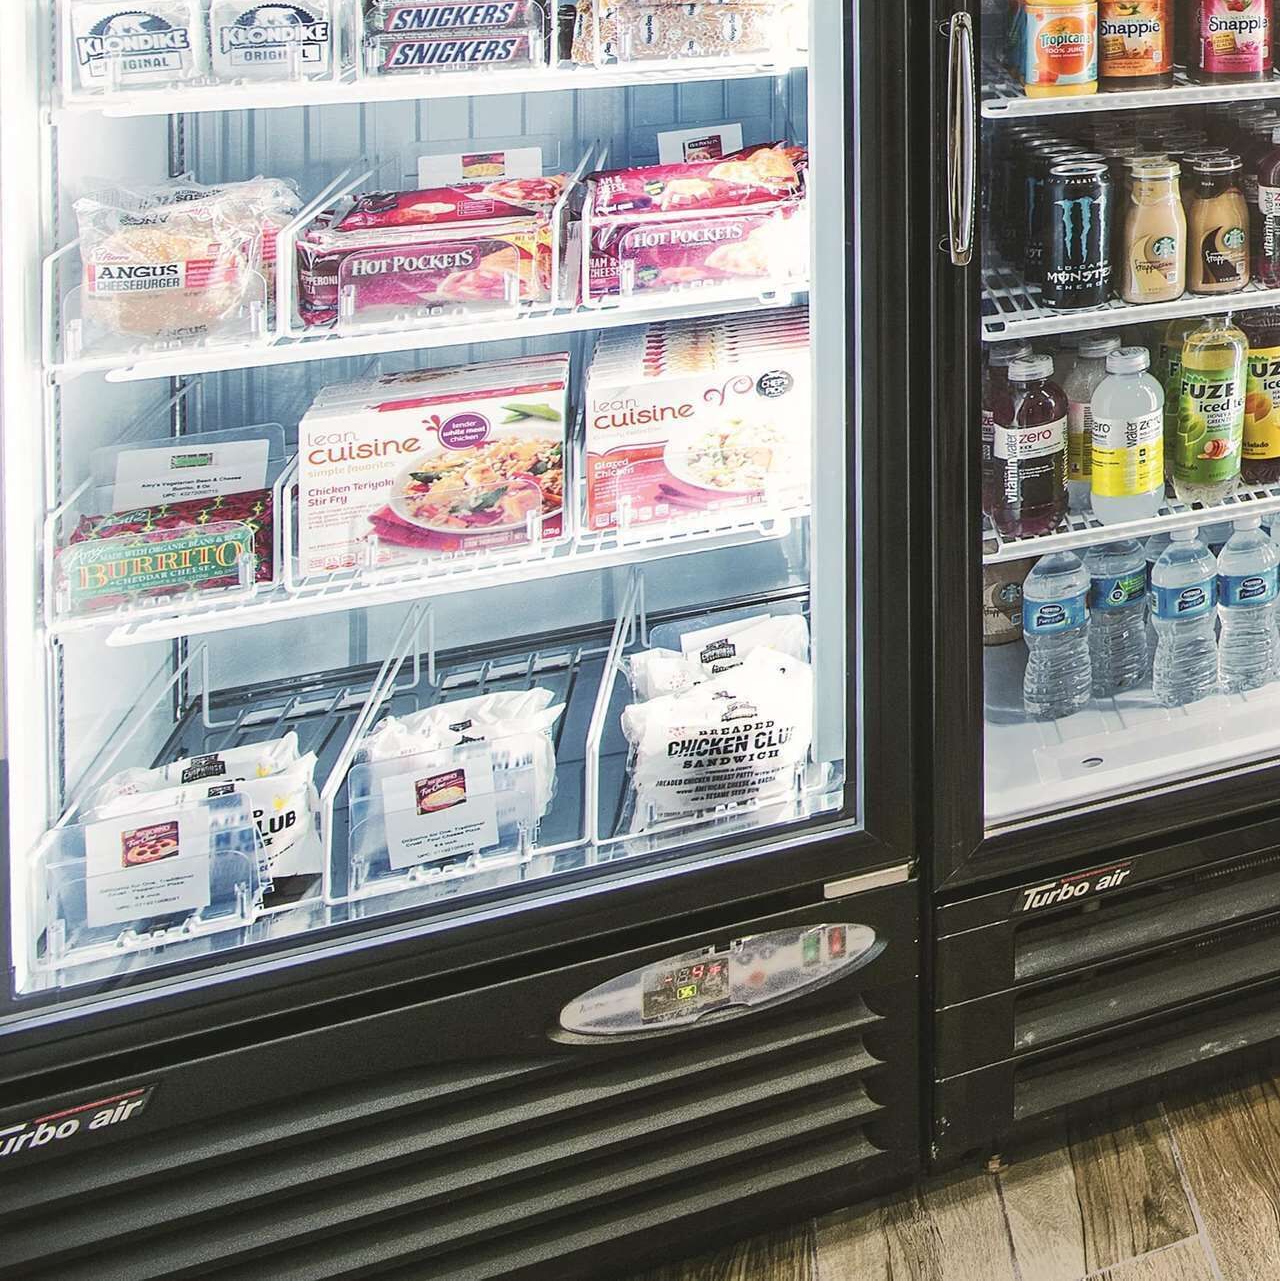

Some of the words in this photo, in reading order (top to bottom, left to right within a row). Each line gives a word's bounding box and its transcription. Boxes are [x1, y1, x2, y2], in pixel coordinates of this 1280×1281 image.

[391, 3, 517, 32] SNICKERS
[1208, 15, 1269, 35] Snapple
[220, 22, 330, 55] KLONDIKE
[1099, 20, 1161, 38] Snapple
[77, 28, 189, 65] KLONDIKE
[391, 38, 517, 68] SNICKERS
[1264, 191, 1275, 258] vitaminwater
[633, 232, 668, 249] HOT
[671, 223, 743, 244] POCKETS
[101, 264, 178, 280] ANGUS
[352, 260, 393, 276] HOT
[396, 250, 473, 271] POCKETS
[97, 277, 180, 290] CHEESEBURGER
[1181, 379, 1236, 400] FUZE
[593, 398, 638, 414] lean
[1200, 397, 1231, 413] iced
[593, 403, 695, 430] cuisine
[307, 430, 358, 448] lean
[449, 434, 479, 443] chicken
[466, 426, 486, 436] meat
[1019, 427, 1053, 444] zero
[307, 436, 422, 466] cuisine
[1004, 433, 1018, 504] vitaminwater
[307, 483, 351, 497] Chicken
[353, 478, 395, 493] Teriyaki
[307, 496, 329, 508] Stir
[329, 495, 348, 507] Fry
[125, 550, 148, 558] WITH
[147, 544, 185, 556] ORGANIC
[79, 541, 242, 590] BURRITO
[699, 720, 775, 737] BREADED
[667, 734, 749, 758] CHICKEN
[682, 749, 780, 769] SANDWICH
[1023, 881, 1091, 911] Turbo
[1095, 869, 1131, 891] air
[89, 1092, 144, 1127] air
